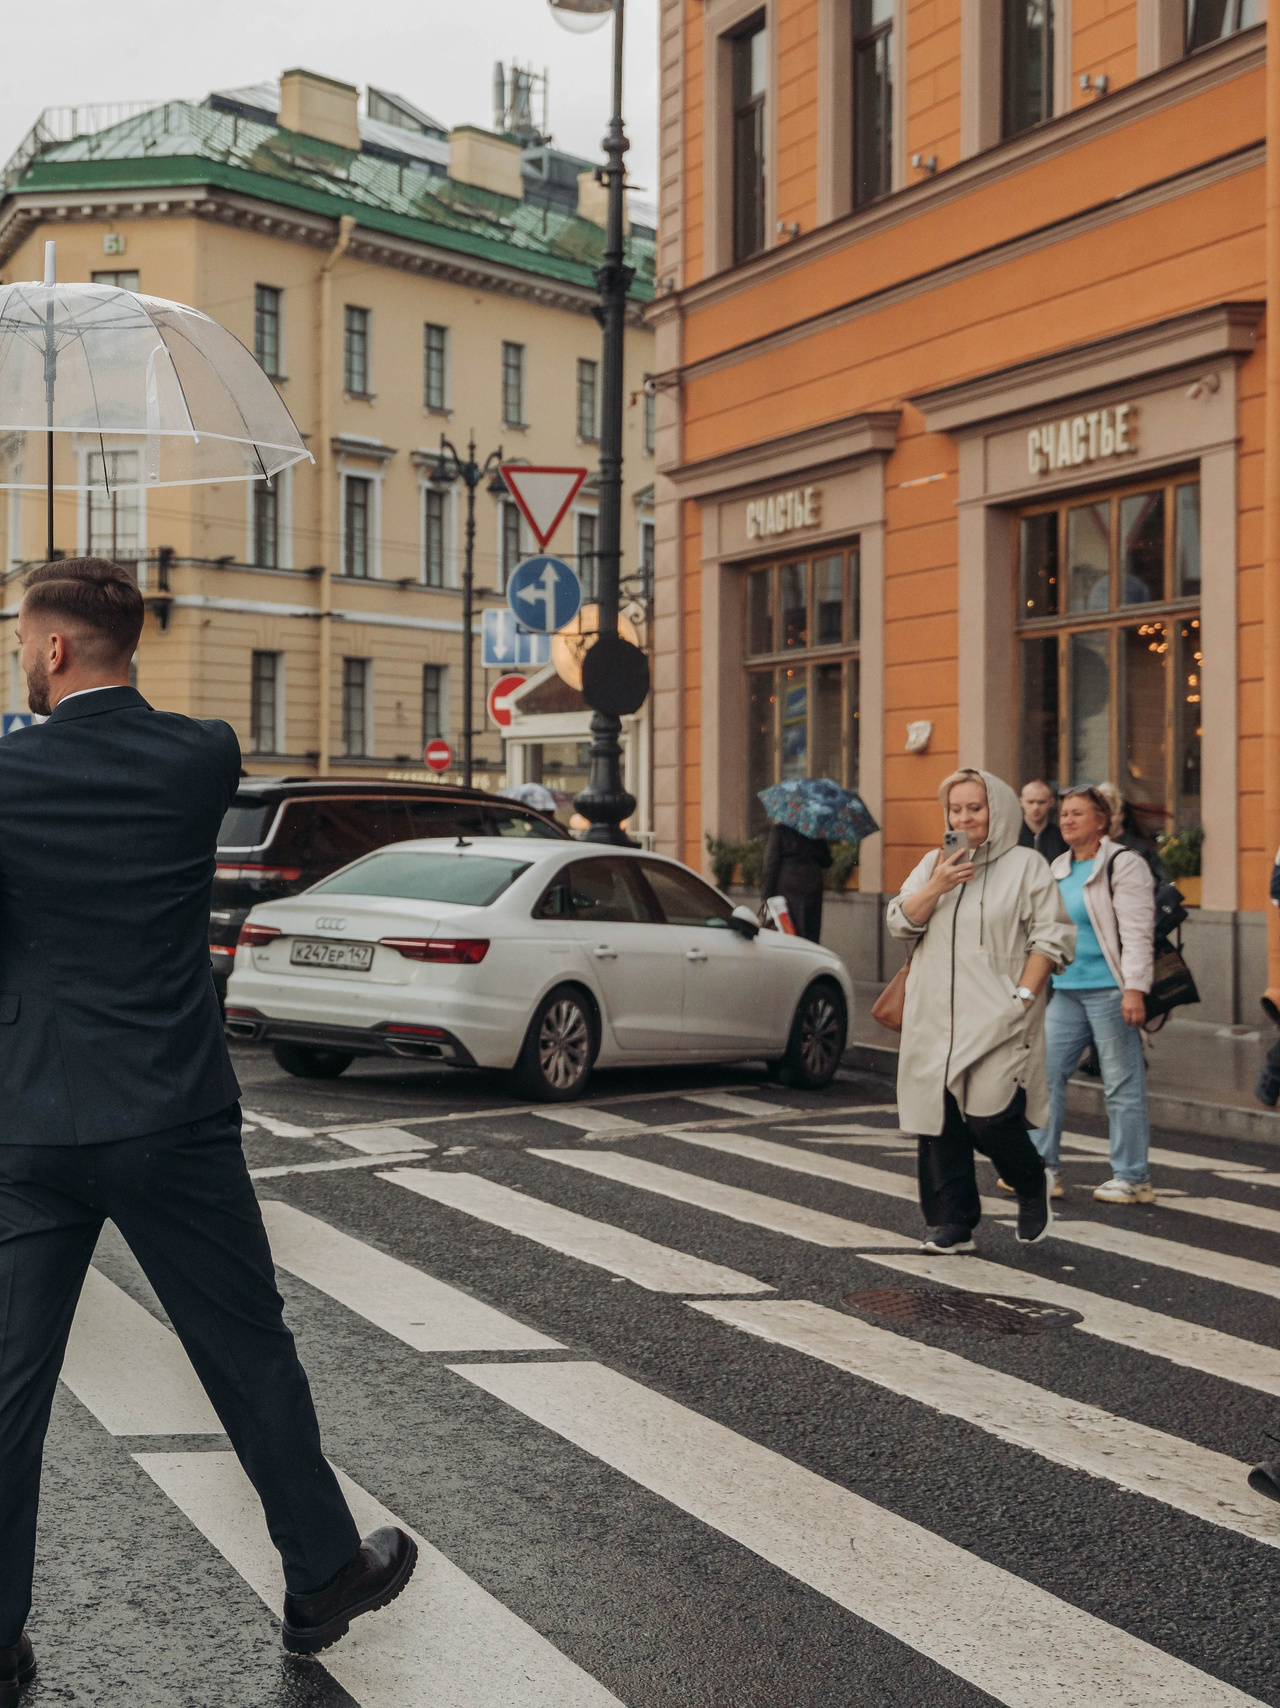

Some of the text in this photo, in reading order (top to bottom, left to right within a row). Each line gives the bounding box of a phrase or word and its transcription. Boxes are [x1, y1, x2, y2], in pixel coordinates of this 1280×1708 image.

[1027, 403, 1131, 475] СЧАСТЬЕ
[746, 485, 814, 540] СЧАСТЬЕ
[348, 947, 369, 962] 147
